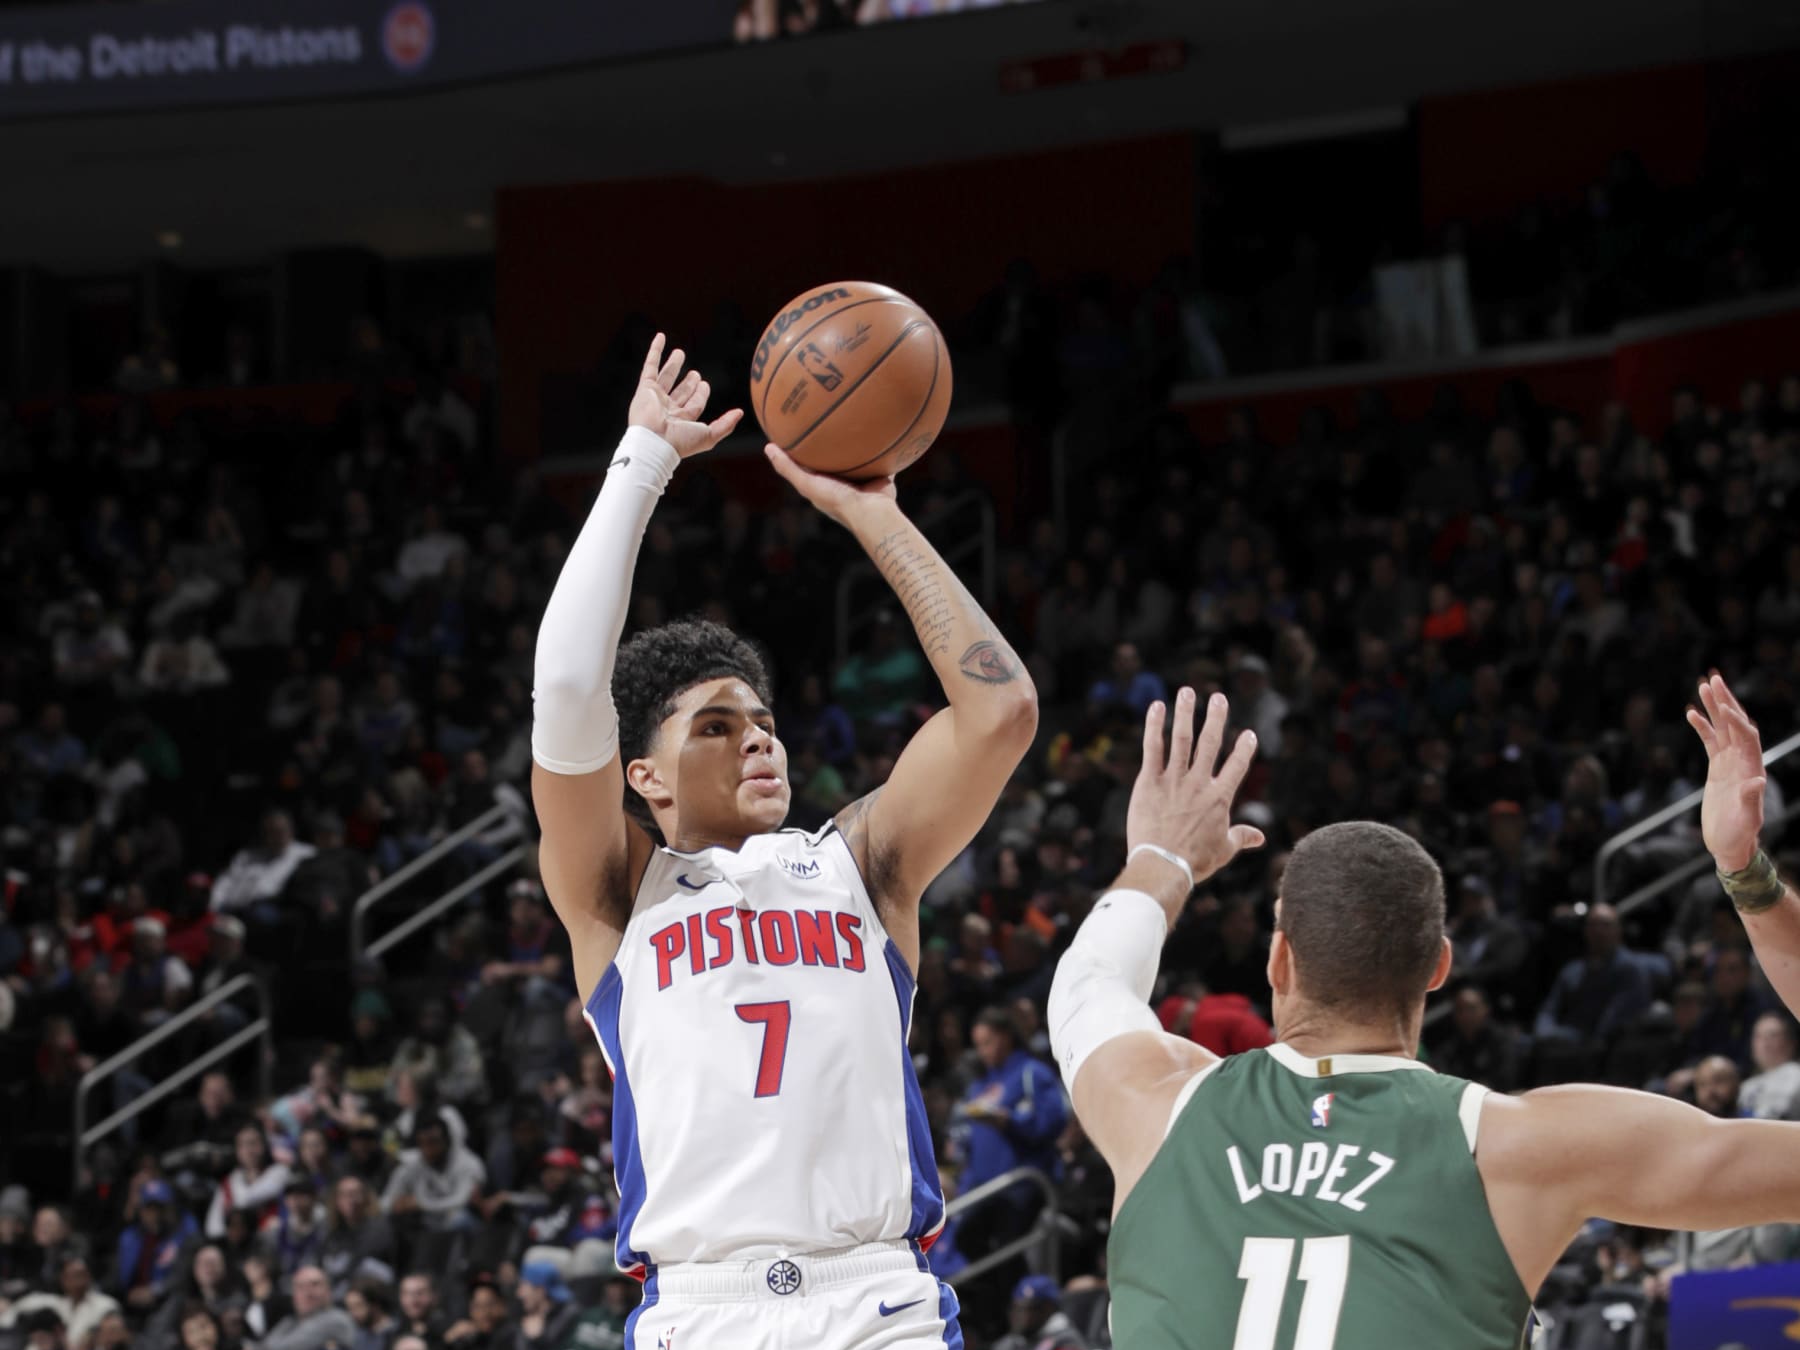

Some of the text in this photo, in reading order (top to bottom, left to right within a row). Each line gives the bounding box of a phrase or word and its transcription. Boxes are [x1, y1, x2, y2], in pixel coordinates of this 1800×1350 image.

[21, 40, 80, 82] the
[90, 32, 217, 80] Detroit
[225, 25, 362, 68] Pistons
[751, 287, 851, 384] Wilson
[649, 905, 866, 992] PISTONS
[734, 1000, 791, 1098] 7
[1226, 1141, 1396, 1212] LOPEZ
